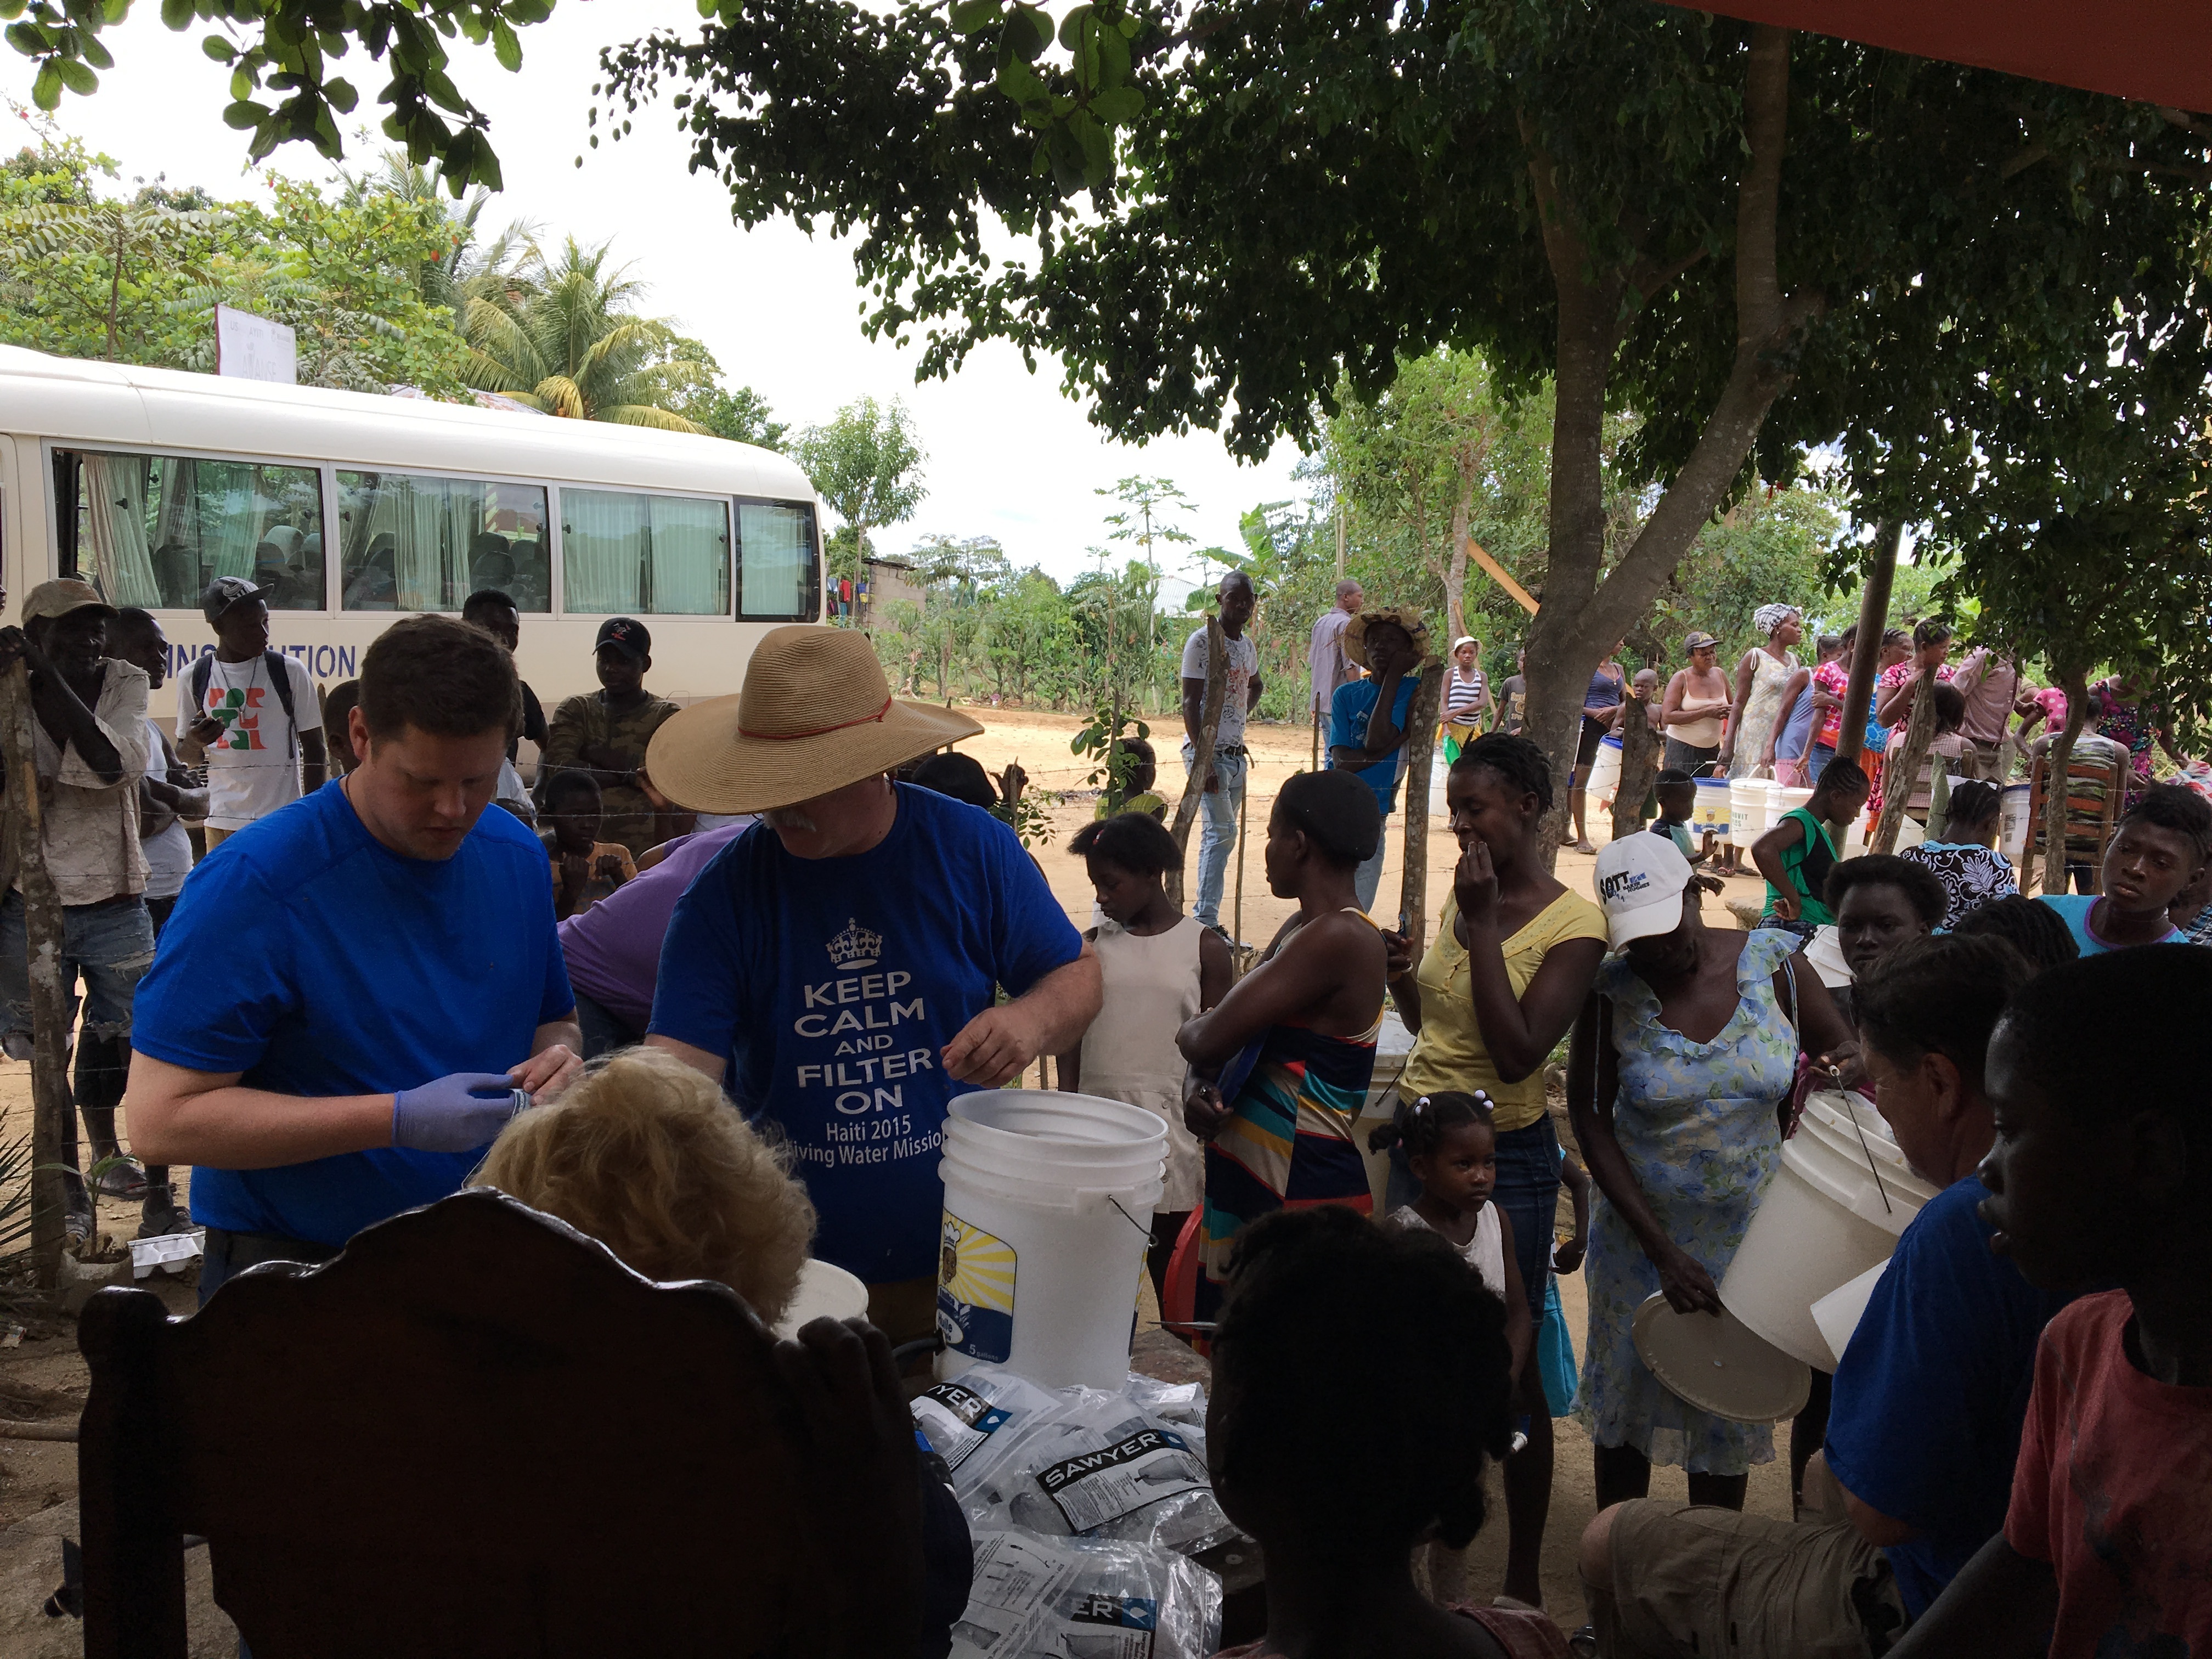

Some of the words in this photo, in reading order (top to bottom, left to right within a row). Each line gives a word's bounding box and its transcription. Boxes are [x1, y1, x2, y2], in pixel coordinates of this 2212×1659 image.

[1600, 871, 1629, 905] SOTT
[804, 970, 911, 1008] KEEP
[794, 997, 925, 1038] CALM
[834, 1035, 893, 1057] AND
[797, 1047, 934, 1088] FILTER
[835, 1084, 903, 1115] ON
[826, 1121, 866, 1142] Haiti
[871, 1114, 911, 1140] 2015
[790, 1140, 834, 1168] iving
[838, 1142, 889, 1164] Water
[894, 1130, 945, 1159] Missio
[969, 1344, 977, 1355] 5
[977, 1351, 998, 1361] gallons
[1046, 1432, 1161, 1488] SAWYER
